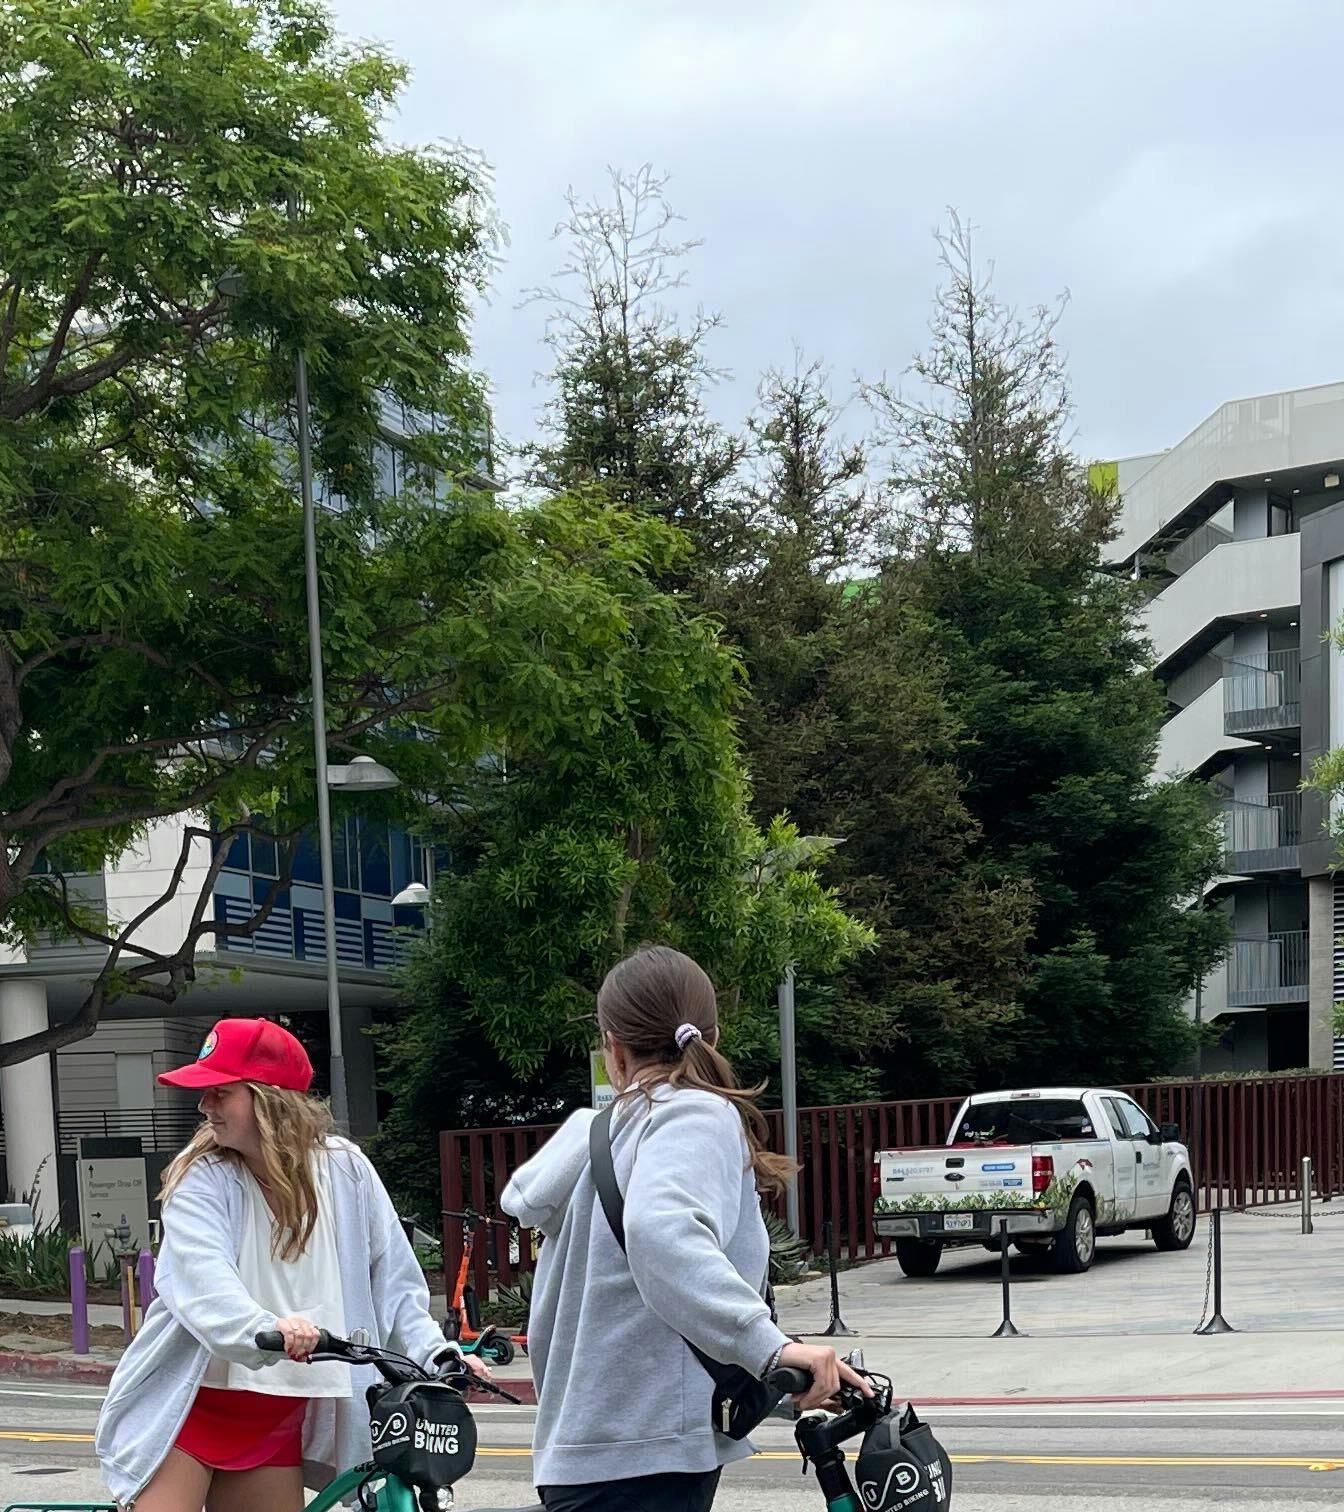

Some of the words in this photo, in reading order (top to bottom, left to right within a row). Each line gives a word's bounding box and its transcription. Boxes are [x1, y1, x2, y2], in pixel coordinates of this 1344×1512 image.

[392, 1419, 401, 1430] B
[865, 1488, 877, 1502] U
[895, 1471, 912, 1486] B
